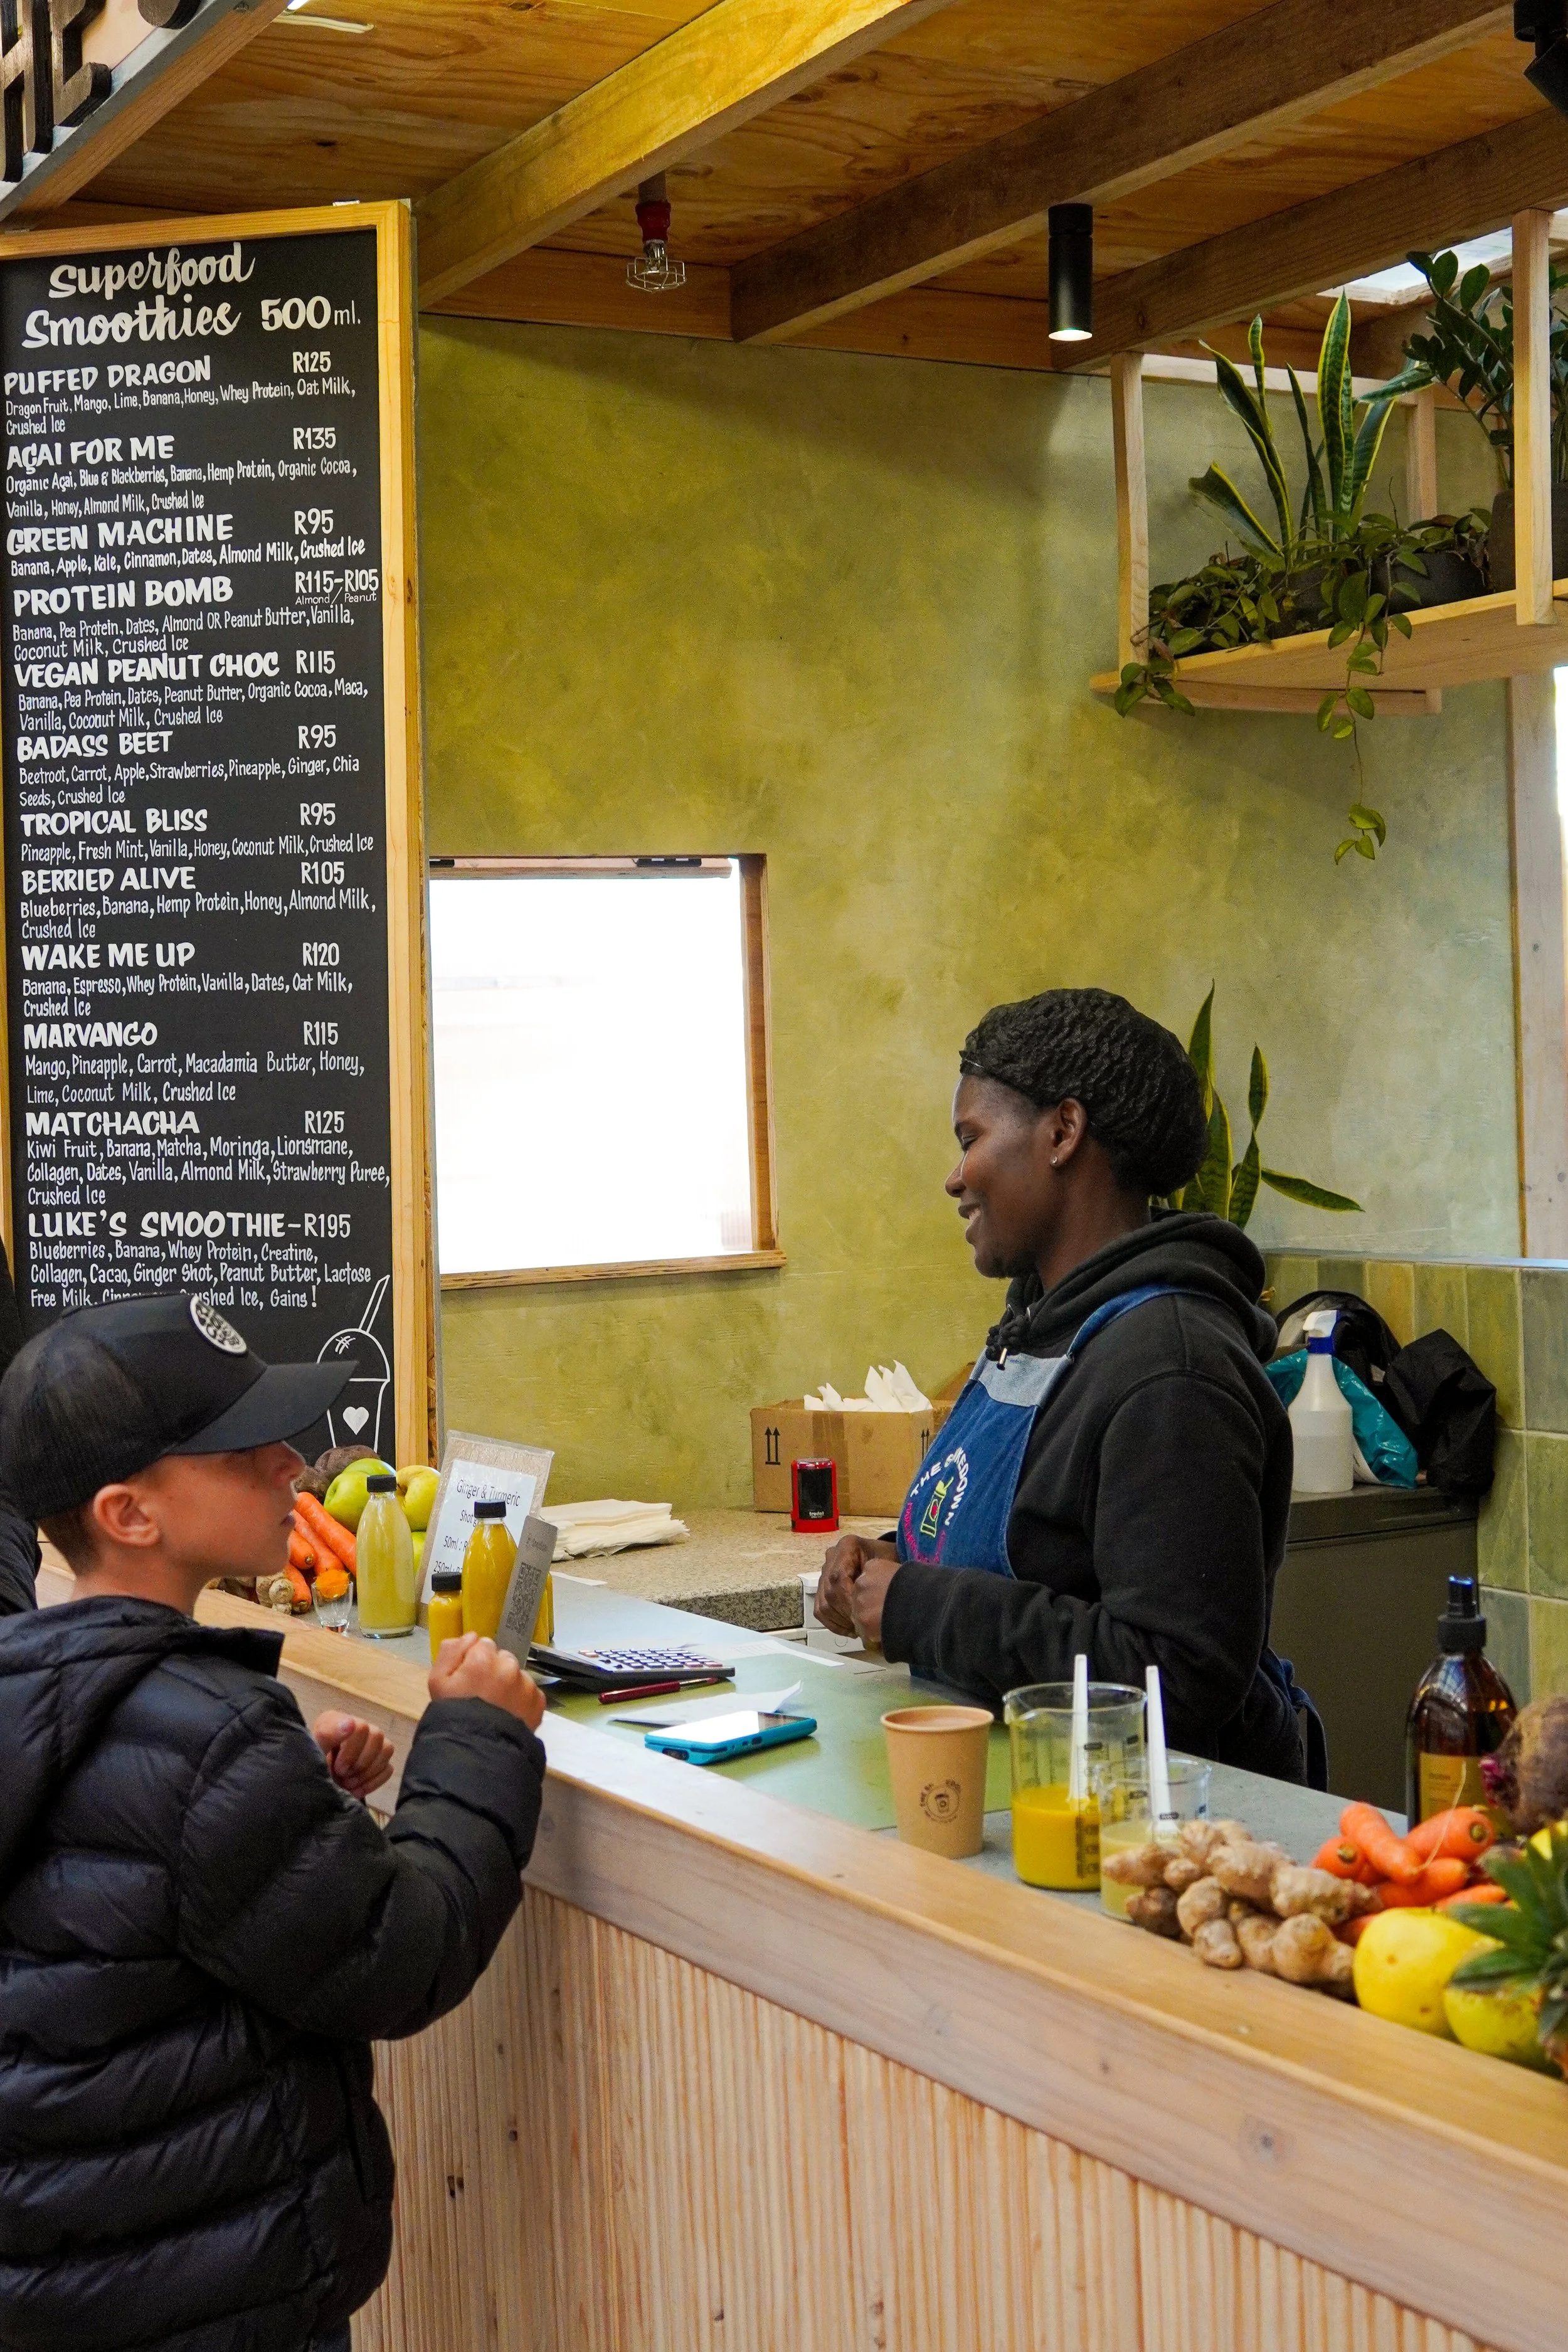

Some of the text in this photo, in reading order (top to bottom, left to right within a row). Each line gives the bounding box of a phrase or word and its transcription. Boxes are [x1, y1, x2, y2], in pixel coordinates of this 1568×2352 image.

[48, 241, 256, 300] Superfood
[21, 293, 242, 349] Smoothies
[260, 295, 331, 331] 500
[3, 354, 211, 396] PUFFED DRAGON
[292, 351, 331, 373] R125
[6, 376, 356, 420] Dragon Fruit, Mango, Lime, Whey Protein, Oat Milk,
[6, 414, 66, 436] Crushed Ice
[293, 426, 336, 450] R135
[6, 435, 175, 475] AÇAI FOR ME
[6, 457, 317, 497] Organic Açai, Blue & Blackberries, Protein, Organic
[6, 489, 205, 521] Vanilla, Milk, Crushed Ice
[6, 513, 233, 556] GREEN MACHINE
[294, 507, 334, 535] R95
[11, 535, 366, 578] Banana, Apple, Kale, Almond Ice
[13, 575, 233, 617] PROTEIN BOMB
[294, 590, 377, 606] Almond Peanut
[13, 608, 263, 642] Banana, Pea Protein, Dates, Almond OR Peanut
[14, 633, 189, 662] Coconut Milk, Crushed Ice
[13, 651, 280, 688] VEGAN PEANUT CHOC
[295, 650, 336, 675] R115
[85, 677, 368, 707] Protein, Dates, Peanut Butter, Organic Cocoa, Maca,
[19, 705, 223, 734] Vanilla, Coconut Milk, Crushed Ice
[17, 730, 174, 763] BADASS BEET
[298, 724, 337, 750] R95
[19, 754, 359, 785] Beetroot, Carrot, Ginger, Chia
[19, 783, 126, 810] Seeds, Crushed Ice
[19, 808, 208, 837] TROPICAL BLISS
[300, 802, 336, 826] R95
[21, 833, 374, 866] Pineapple, Fresh Ice
[21, 866, 196, 896] BERRIED ALIVE
[300, 861, 345, 885] R105
[157, 894, 191, 919] Hemp
[21, 916, 96, 939] Crushed Ice
[21, 941, 196, 971] WAKE ME UP
[302, 941, 340, 967] R120
[23, 970, 353, 997] Banana, Oat Milk,
[23, 995, 91, 1017] Crushed Ice
[23, 1021, 158, 1050] MARVANGO
[303, 1020, 339, 1046] R115
[137, 1050, 365, 1078] Carrot, Macadamia Butter, Honey,
[27, 1080, 236, 1107] Lime, Coconut Milk, Crushed Ice
[25, 1110, 200, 1137] MATCHACHA
[305, 1110, 345, 1134] R125
[27, 1135, 353, 1163] Kiwi Moringa, Lionsmane,
[27, 1157, 390, 1188] Collagen, Dates, Vanilla, Almond Puree,
[28, 1184, 106, 1206] Crushed Ice
[28, 1209, 127, 1237] LUKE'S
[29, 1239, 318, 1264] Blueberries, Banana, Whey Protein, Creatine,
[31, 1261, 371, 1288] Collagen, Cacao, Ginger Butter, Lactose
[31, 1288, 57, 1308] Free
[240, 1286, 264, 1311] Ice,
[456, 1478, 521, 1507] Ginger & Turmeric
[910, 1461, 942, 1498] THE
[459, 1509, 474, 1524] Shot
[443, 1535, 459, 1550] 50ml
